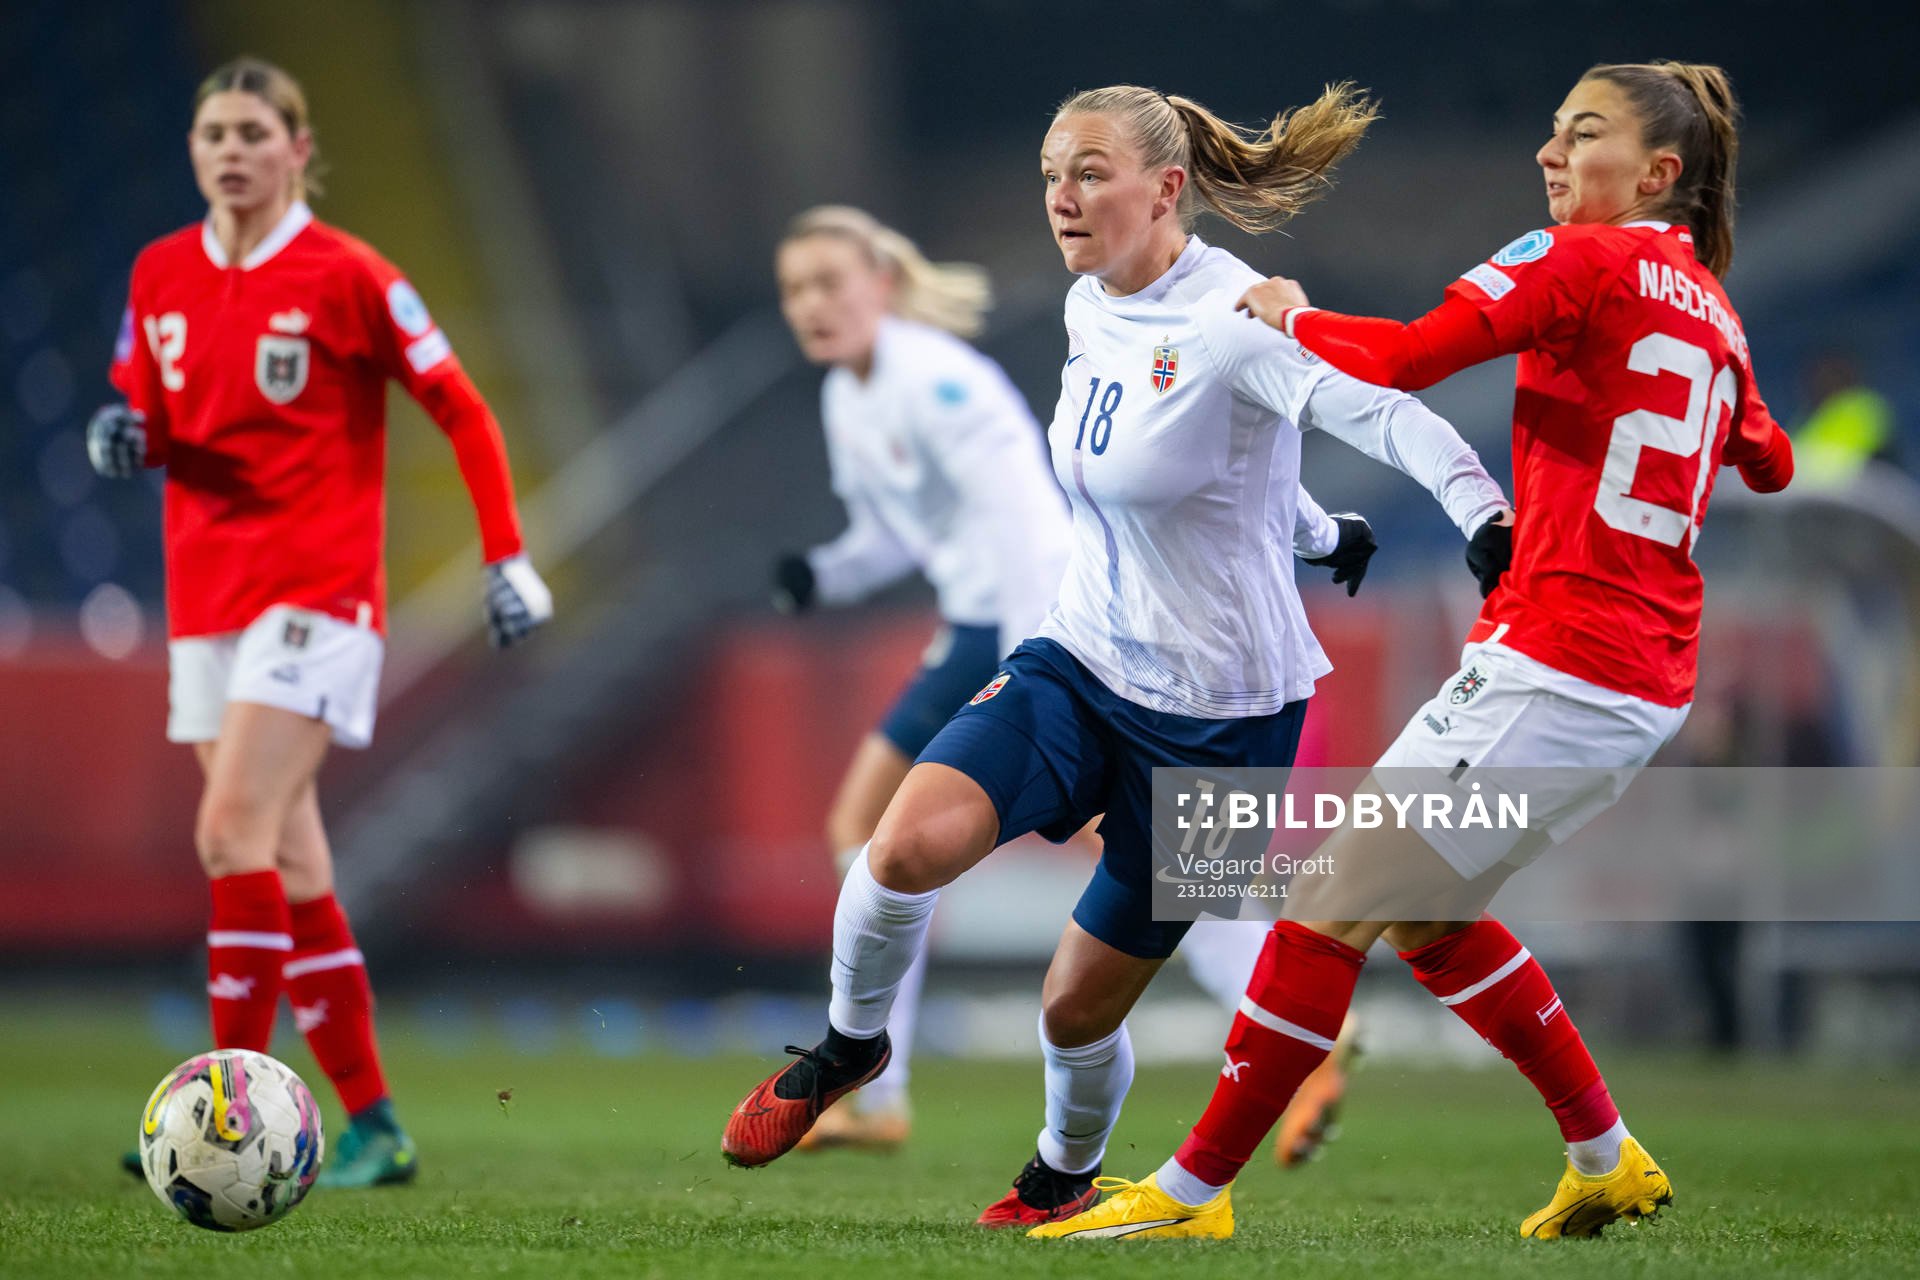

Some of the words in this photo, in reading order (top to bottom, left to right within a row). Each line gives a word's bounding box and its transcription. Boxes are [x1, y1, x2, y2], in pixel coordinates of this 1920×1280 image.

[143, 312, 187, 392] 12
[1075, 376, 1123, 456] 18
[1179, 779, 1248, 859] 18
